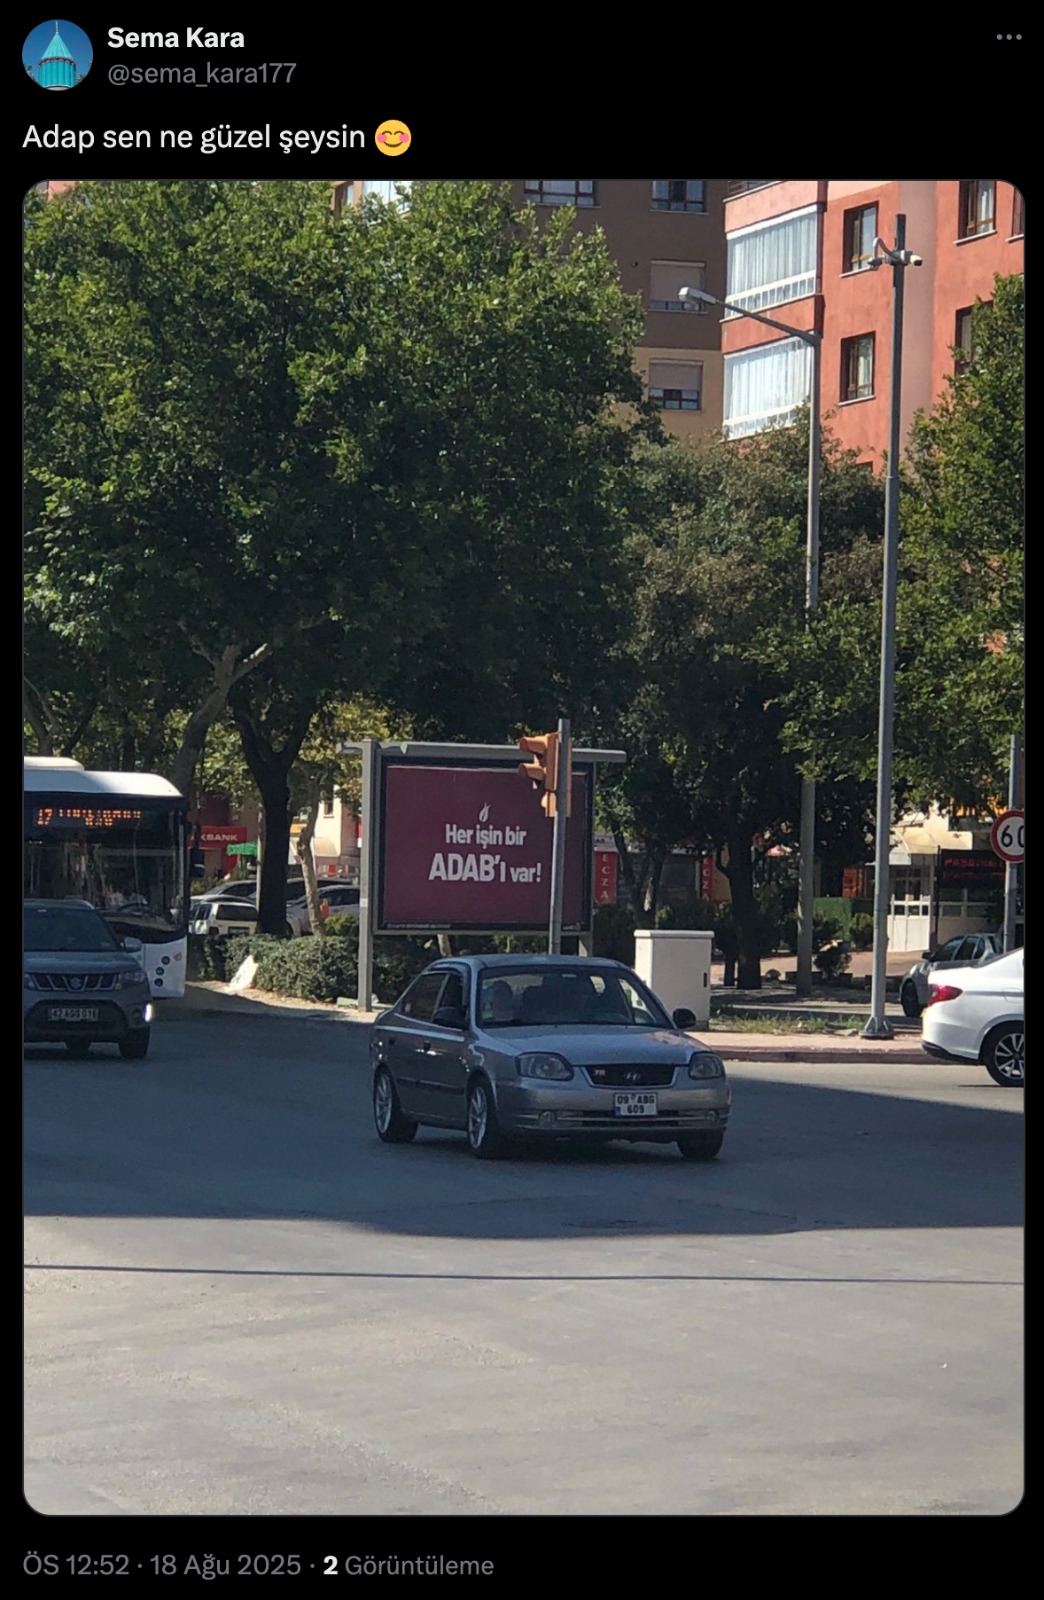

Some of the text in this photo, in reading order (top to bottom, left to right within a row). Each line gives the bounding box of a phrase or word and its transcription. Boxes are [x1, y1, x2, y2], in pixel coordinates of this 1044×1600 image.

[445, 823, 527, 850] Her işin bir
[510, 862, 542, 883] var!
[617, 1095, 629, 1104] 09
[627, 1105, 645, 1114] 609
